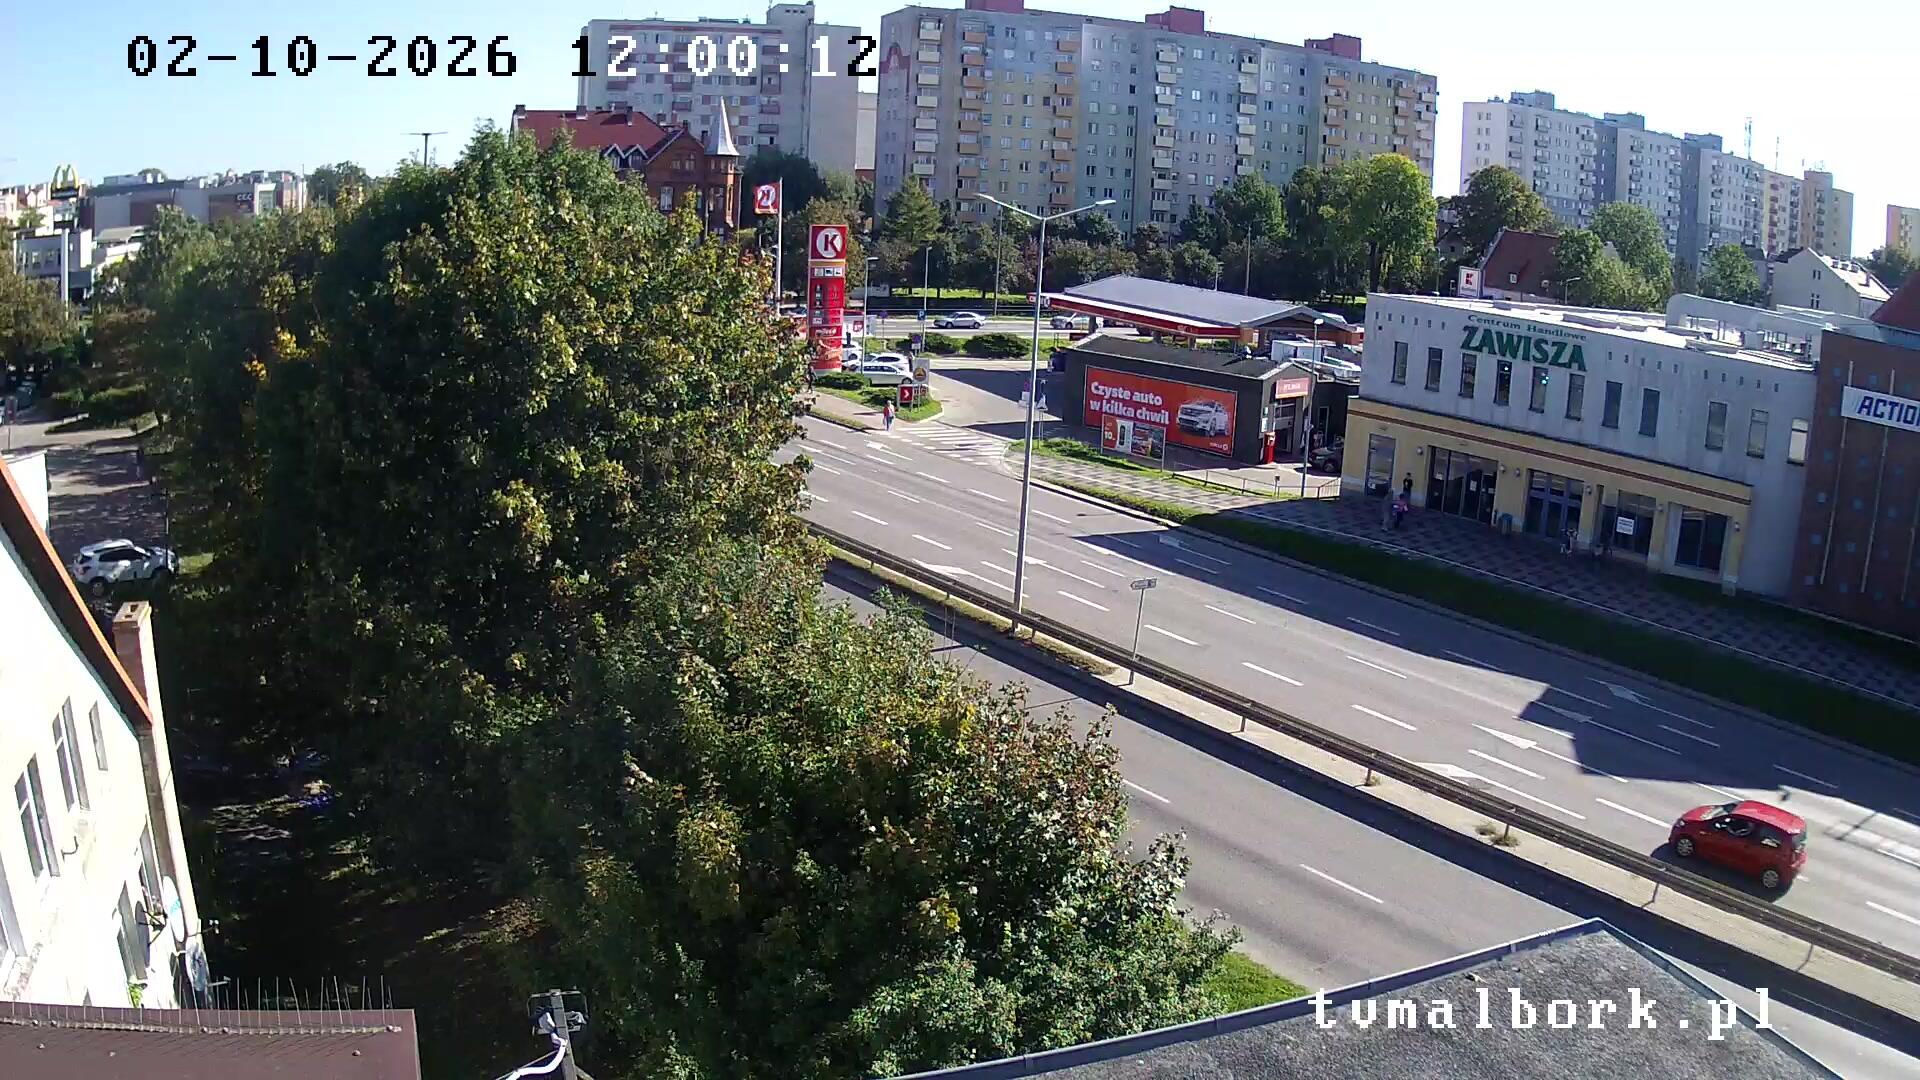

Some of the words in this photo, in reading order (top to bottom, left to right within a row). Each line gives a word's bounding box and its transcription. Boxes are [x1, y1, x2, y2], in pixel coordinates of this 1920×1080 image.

[1468, 314, 1521, 330] Centrum
[1527, 324, 1587, 341] Handlowe
[1461, 325, 1587, 372] ZAWISZA
[1090, 381, 1131, 400] Czyste
[1132, 391, 1163, 406] auto
[1089, 400, 1101, 411] w
[1102, 400, 1135, 418] kilka
[1136, 406, 1170, 425] chwil
